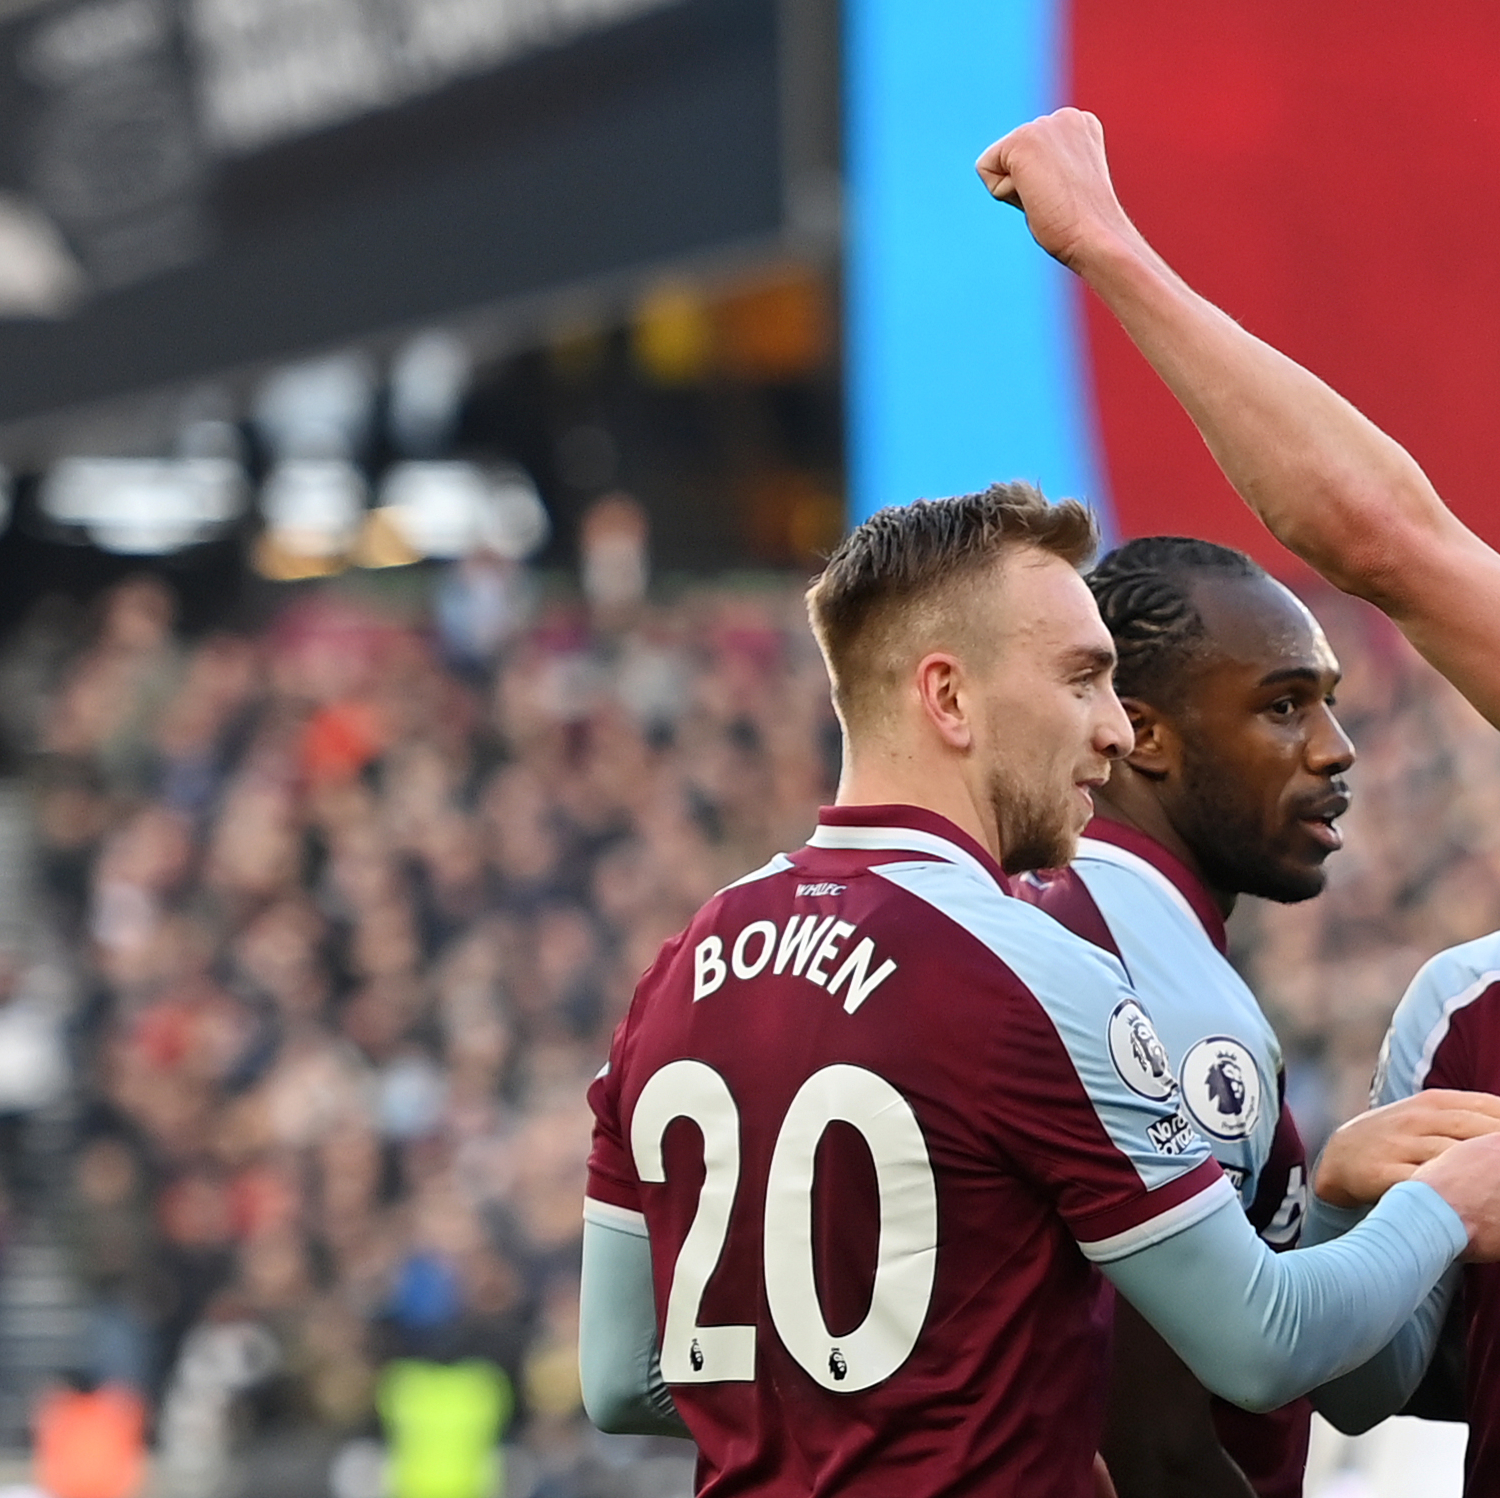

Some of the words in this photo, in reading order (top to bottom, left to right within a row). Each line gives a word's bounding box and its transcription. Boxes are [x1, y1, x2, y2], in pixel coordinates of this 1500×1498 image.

[693, 914, 897, 1015] BOWEN
[1147, 1121, 1172, 1148] No
[630, 1058, 938, 1392] 20
